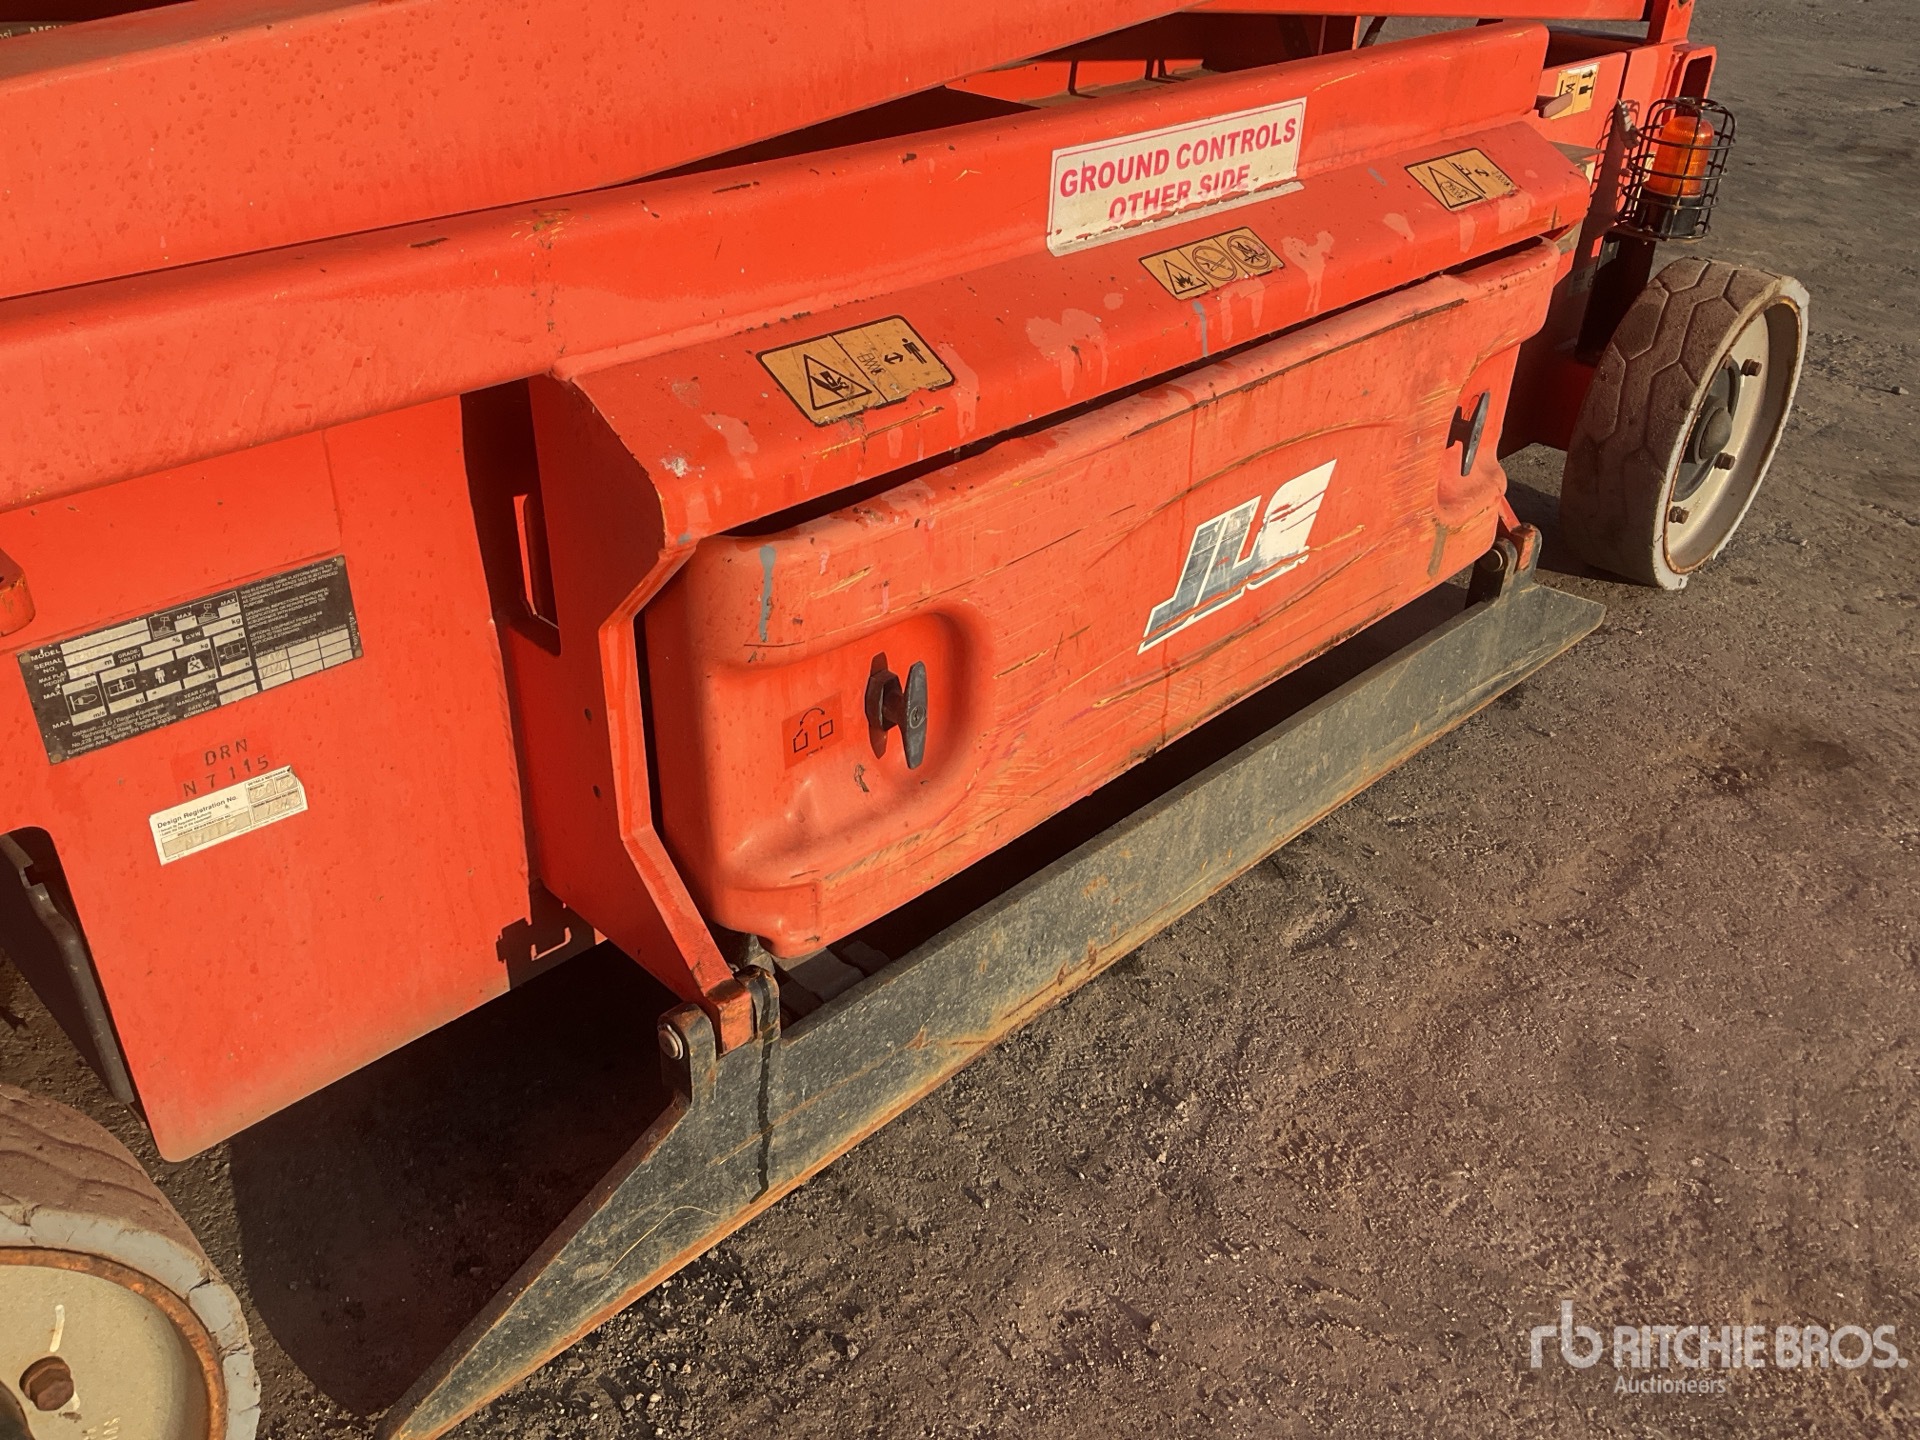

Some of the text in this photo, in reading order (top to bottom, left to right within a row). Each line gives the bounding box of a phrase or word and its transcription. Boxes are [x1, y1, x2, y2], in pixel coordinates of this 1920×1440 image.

[1059, 117, 1297, 198] GROUND CONTROLS
[1108, 164, 1251, 223] OTHER SIDE
[219, 597, 235, 606] MAX
[176, 610, 192, 619] MAX
[231, 616, 240, 625] kg
[30, 647, 60, 661] MODEL
[119, 653, 141, 663] ABILITY
[33, 657, 62, 670] SERIAL
[126, 666, 135, 674] kg
[42, 689, 61, 699] MAX
[52, 719, 70, 729] MAX
[157, 815, 182, 829] Design
[183, 799, 226, 819] Registration
